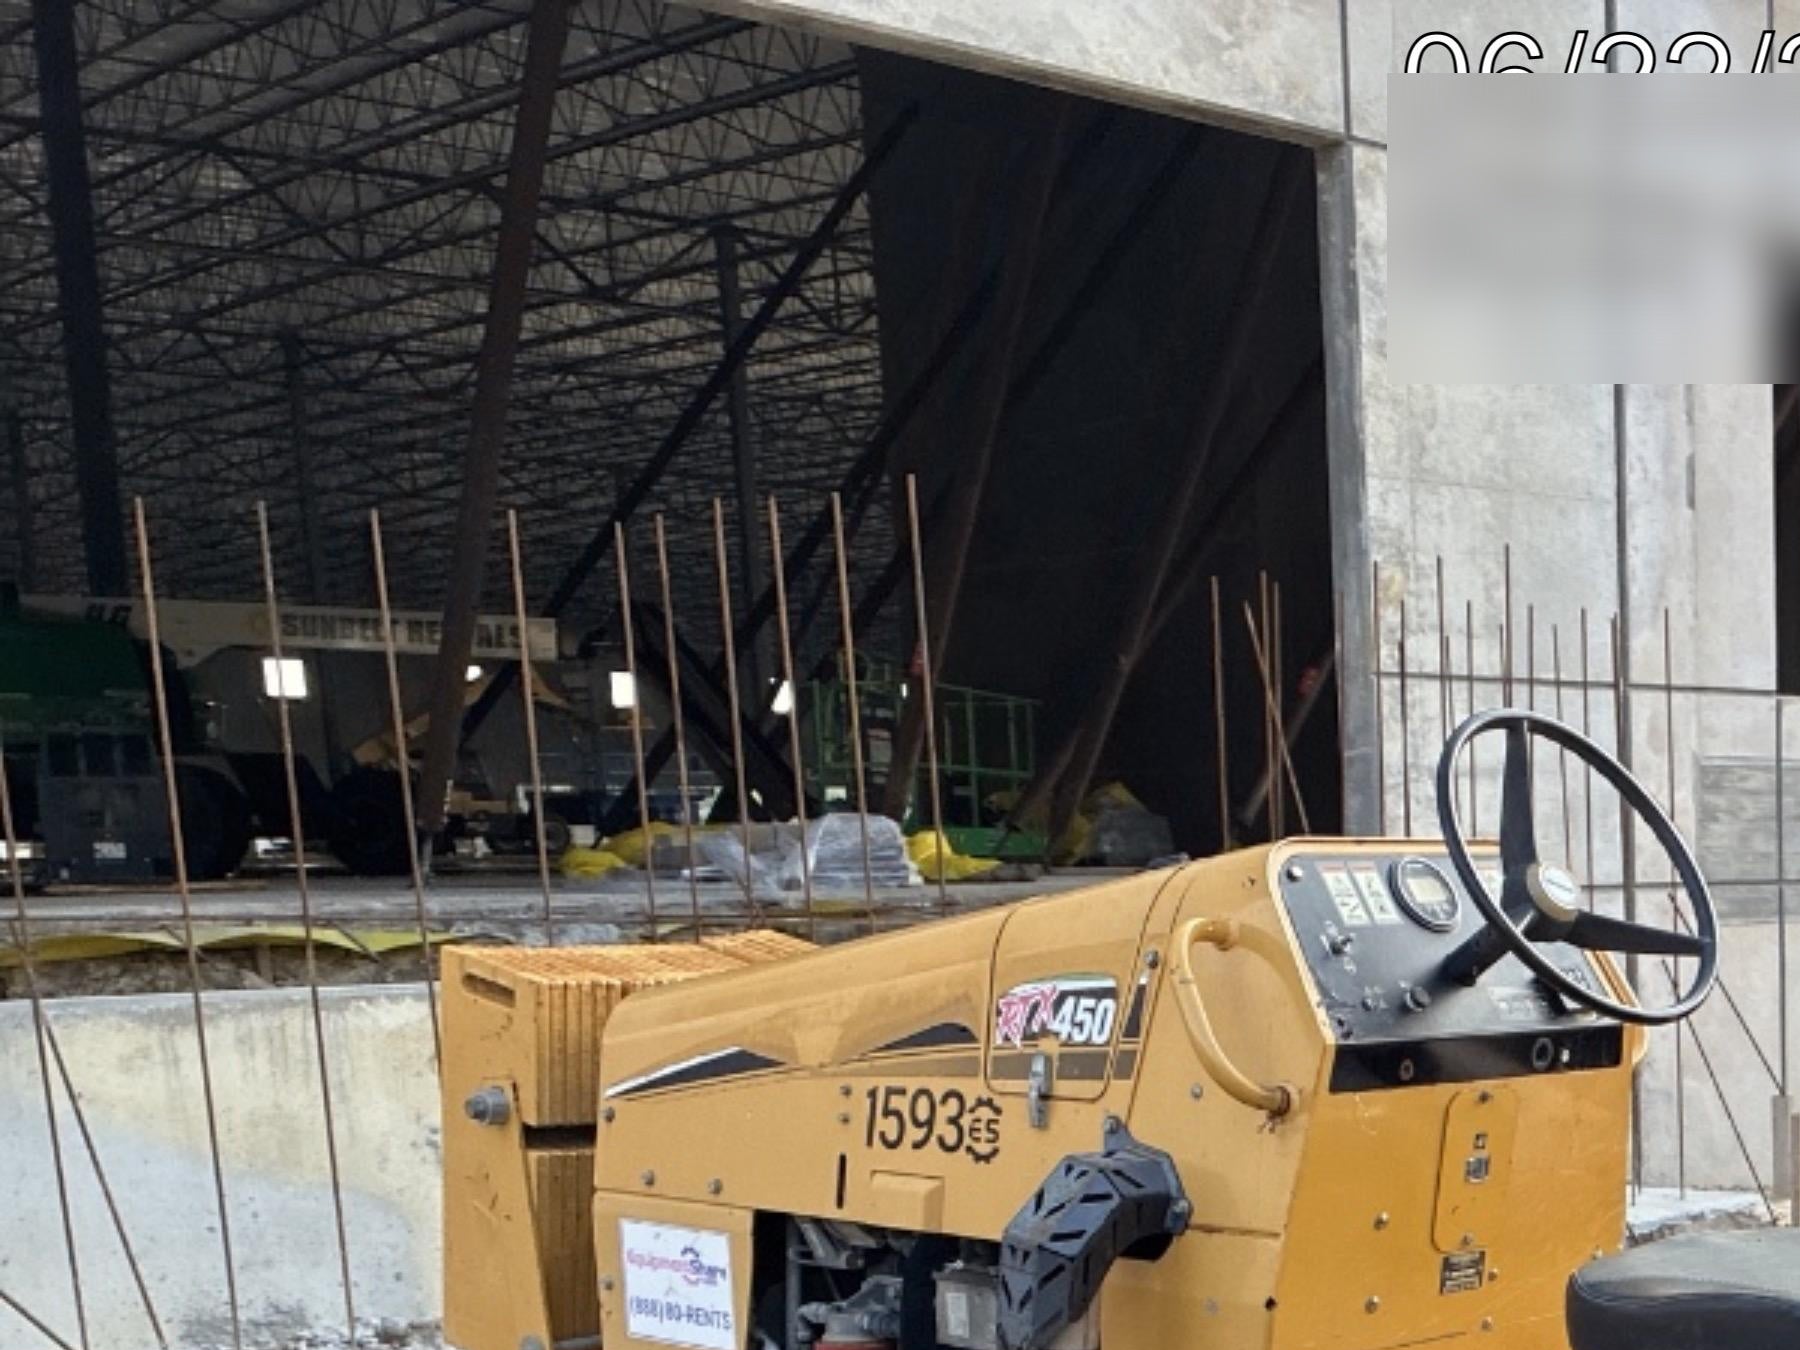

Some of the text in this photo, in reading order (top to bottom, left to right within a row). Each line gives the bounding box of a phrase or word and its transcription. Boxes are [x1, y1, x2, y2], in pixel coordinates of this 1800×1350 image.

[408, 618, 523, 649] REALS
[1053, 996, 1117, 1045] 450
[866, 1085, 966, 1153] 1593
